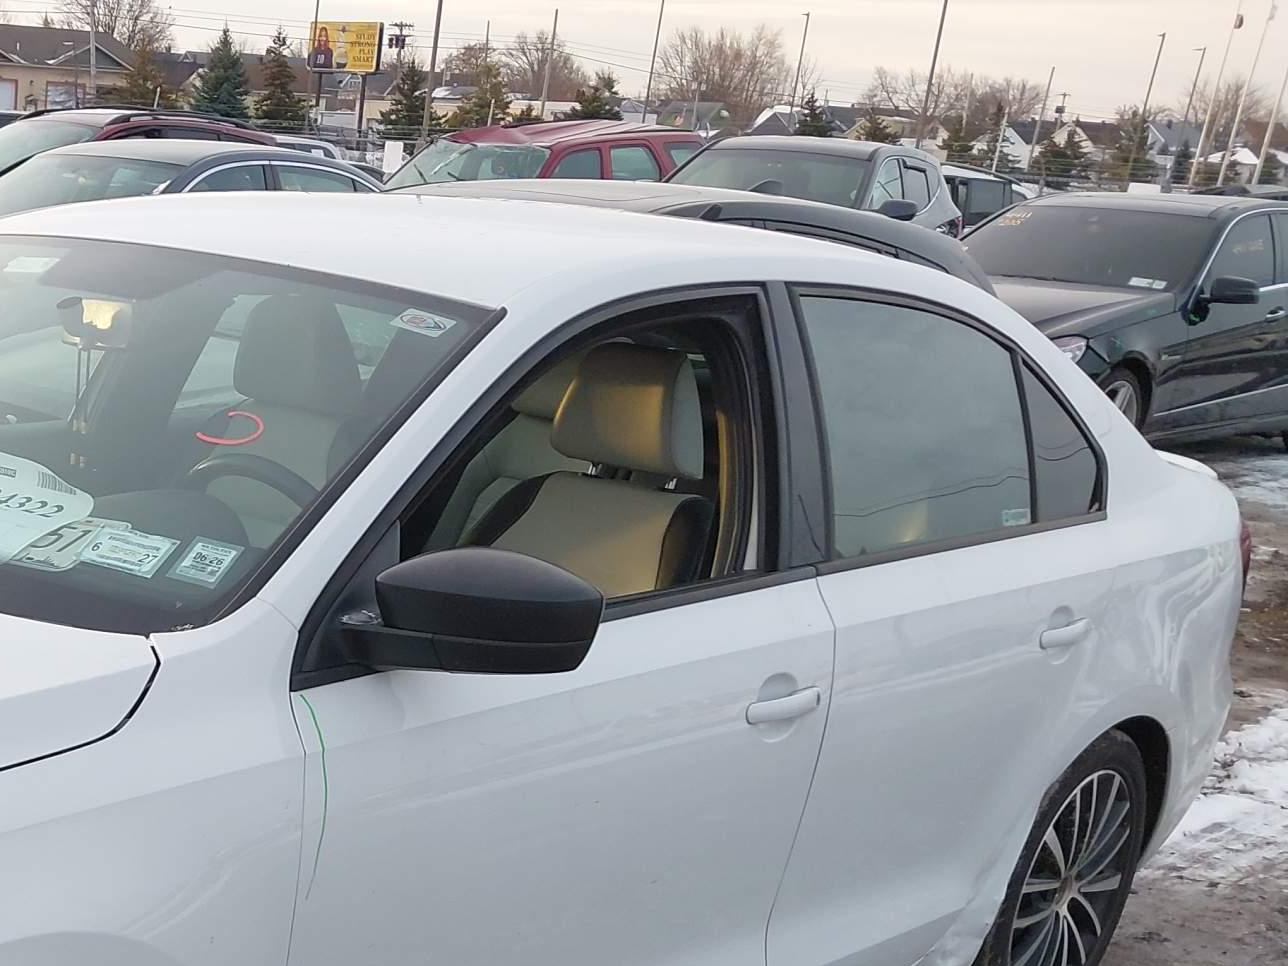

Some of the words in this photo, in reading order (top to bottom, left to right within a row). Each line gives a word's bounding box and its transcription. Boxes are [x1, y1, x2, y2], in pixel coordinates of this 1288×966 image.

[352, 55, 374, 63] SMART
[91, 541, 103, 552] 6
[138, 553, 159, 564] 27
[192, 551, 209, 562] 06
[208, 556, 225, 566] 26
